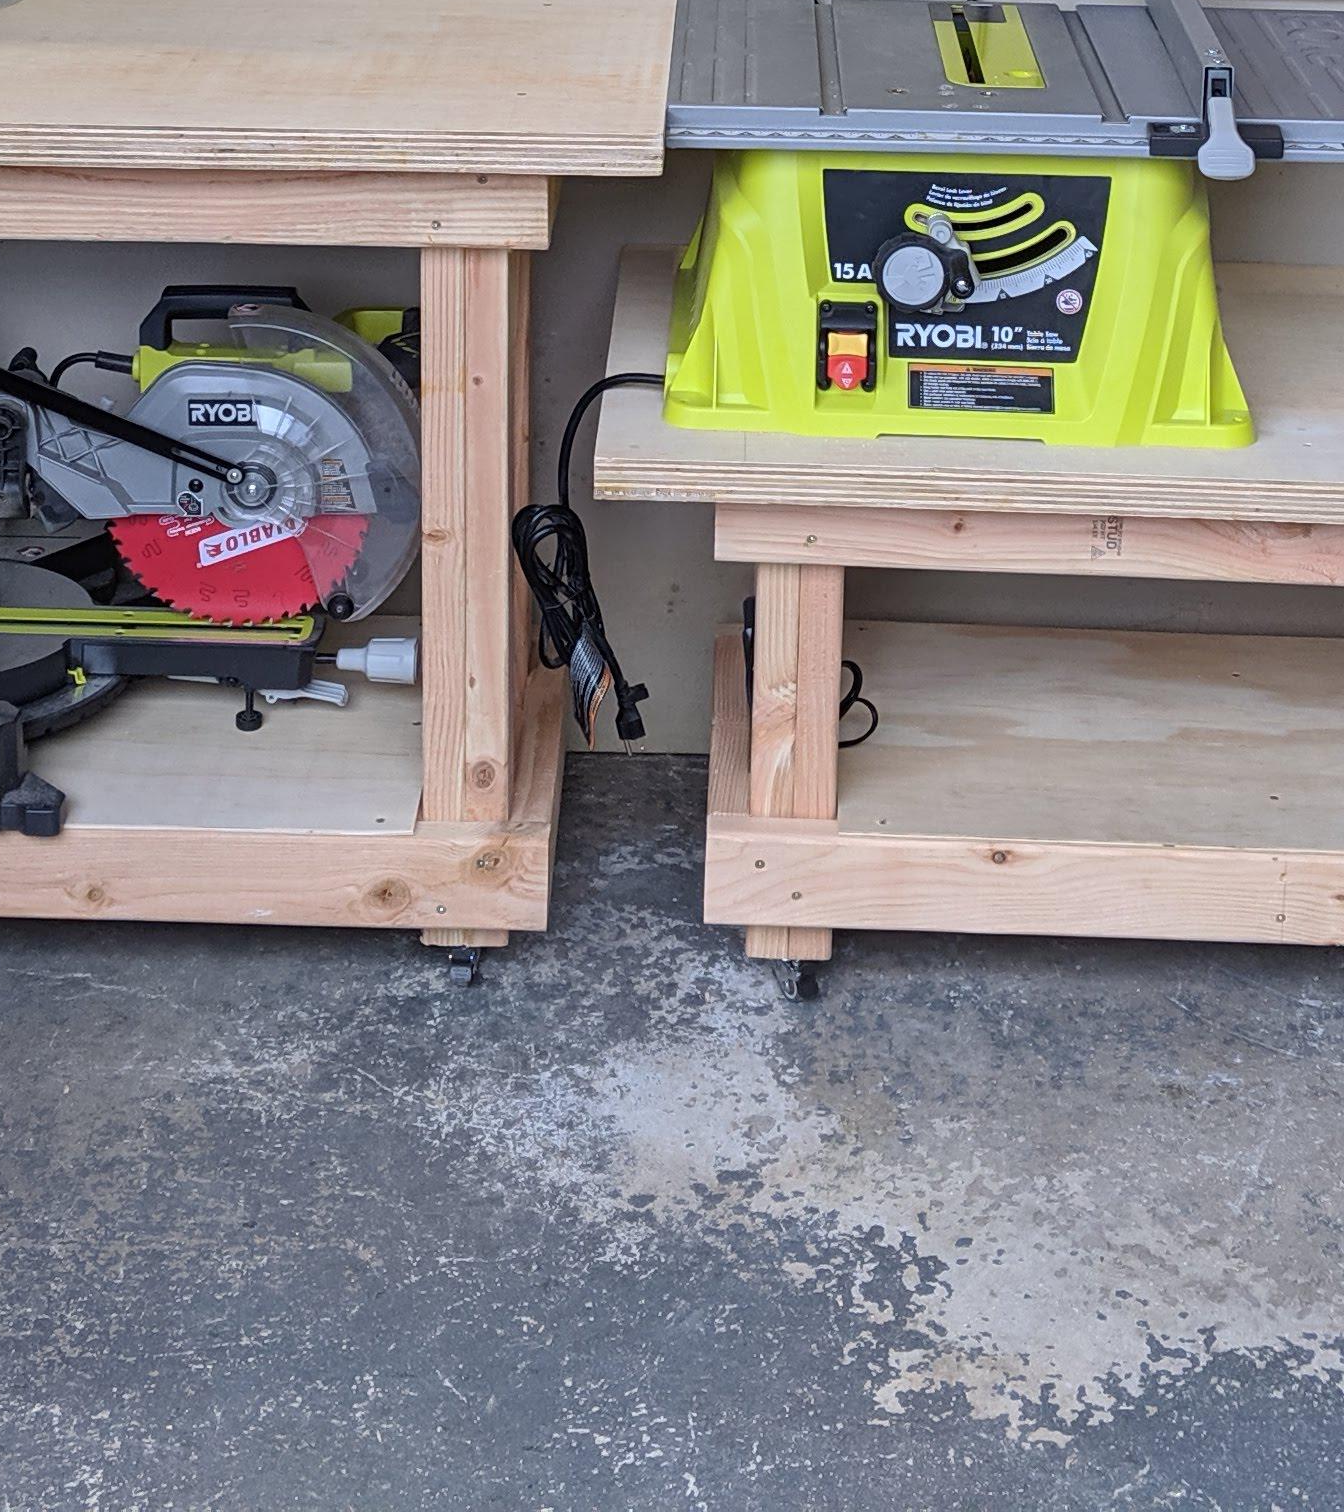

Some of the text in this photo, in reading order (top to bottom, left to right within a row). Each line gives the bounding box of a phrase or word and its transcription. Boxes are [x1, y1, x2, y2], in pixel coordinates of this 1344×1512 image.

[895, 323, 982, 349] RYOBI
[189, 403, 257, 422] RYOBI
[226, 517, 297, 551] DIABLO
